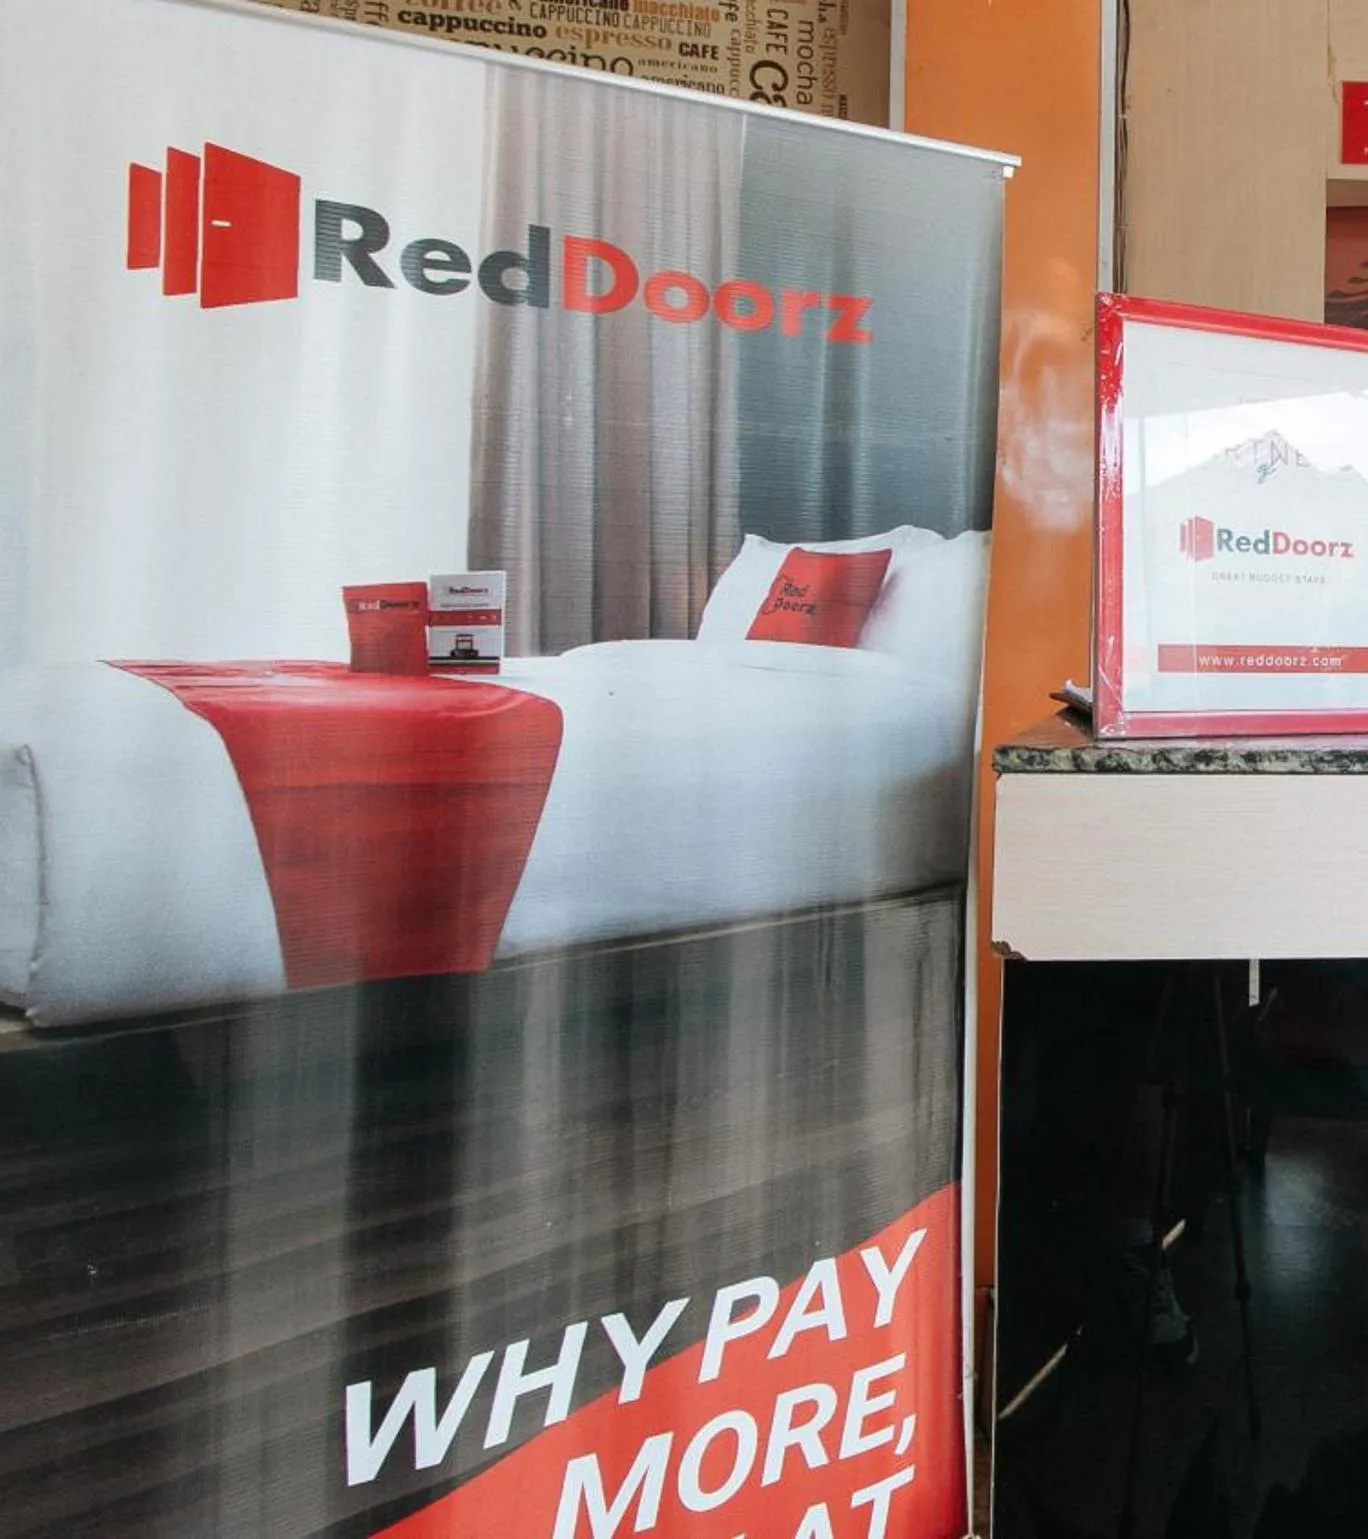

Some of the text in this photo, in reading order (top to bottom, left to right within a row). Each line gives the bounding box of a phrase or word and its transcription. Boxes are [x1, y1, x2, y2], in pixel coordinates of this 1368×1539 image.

[397, 10, 548, 39] cappuccino
[530, 2, 619, 28] CAPPUCCINO
[623, 13, 711, 39] CAPPUCCINO
[555, 25, 672, 50] espresso
[766, 8, 789, 55] CAFE
[678, 42, 719, 61] CAFE
[796, 20, 817, 105] mocha
[312, 199, 874, 344] RedDoorz
[1216, 528, 1355, 559] RedDoorz
[1199, 654, 1342, 668] www.reddoorz.com
[345, 1228, 927, 1487] WHY PAY
[551, 1352, 917, 1539] MORE,
